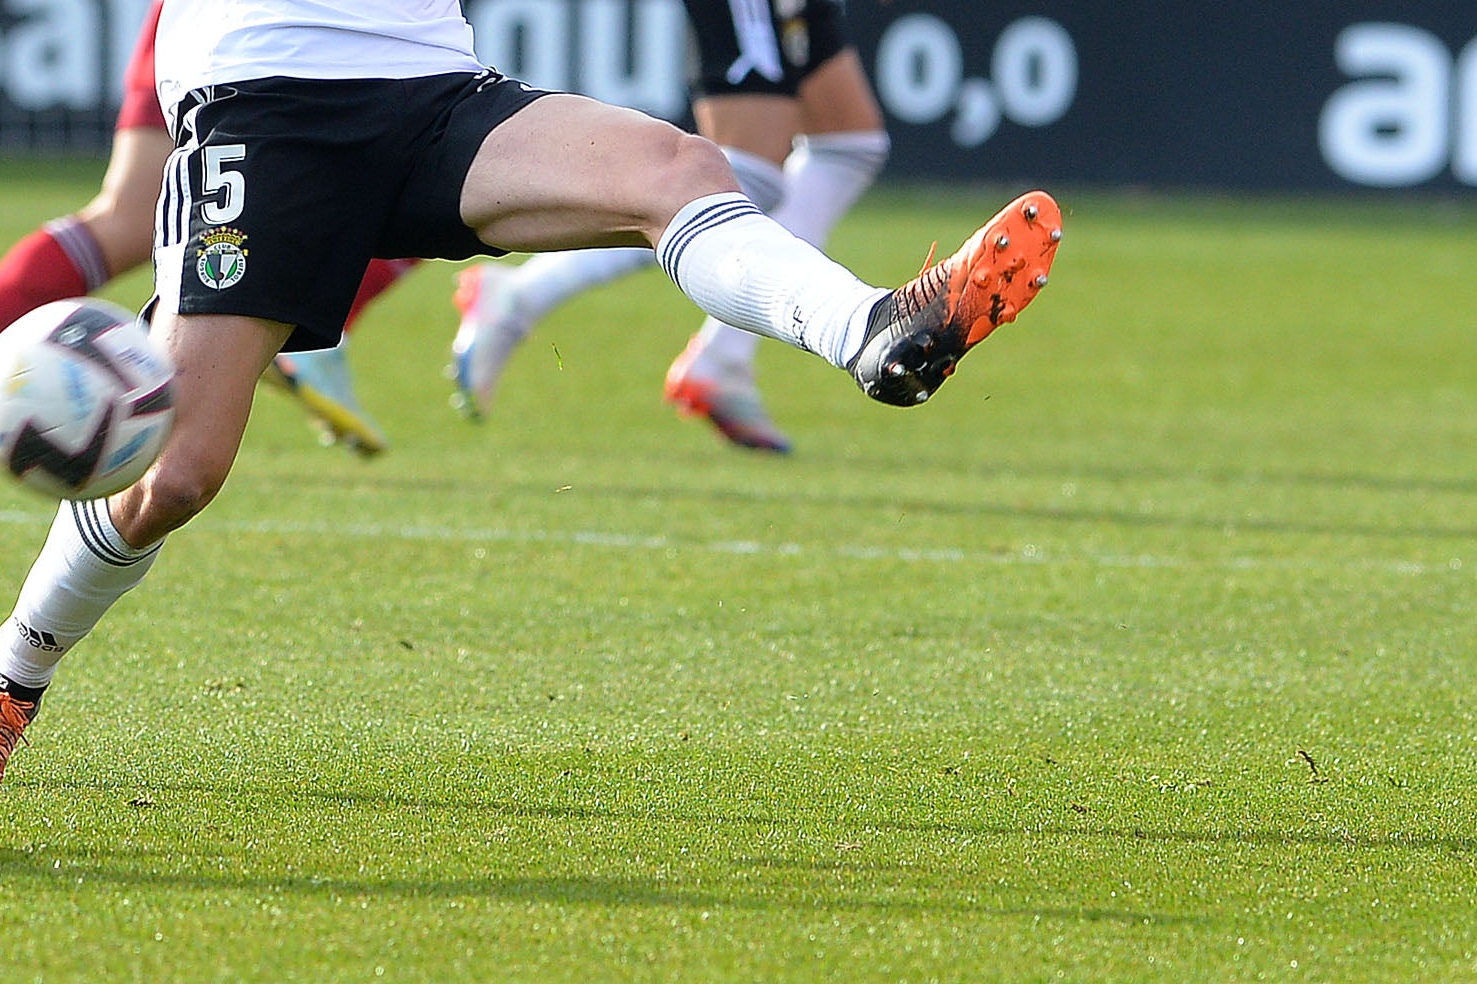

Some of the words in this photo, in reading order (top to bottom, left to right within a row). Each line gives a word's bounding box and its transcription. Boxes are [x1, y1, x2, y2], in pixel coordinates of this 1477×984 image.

[876, 13, 1078, 149] 0,0
[201, 144, 246, 225] 5
[14, 617, 64, 653] didas
